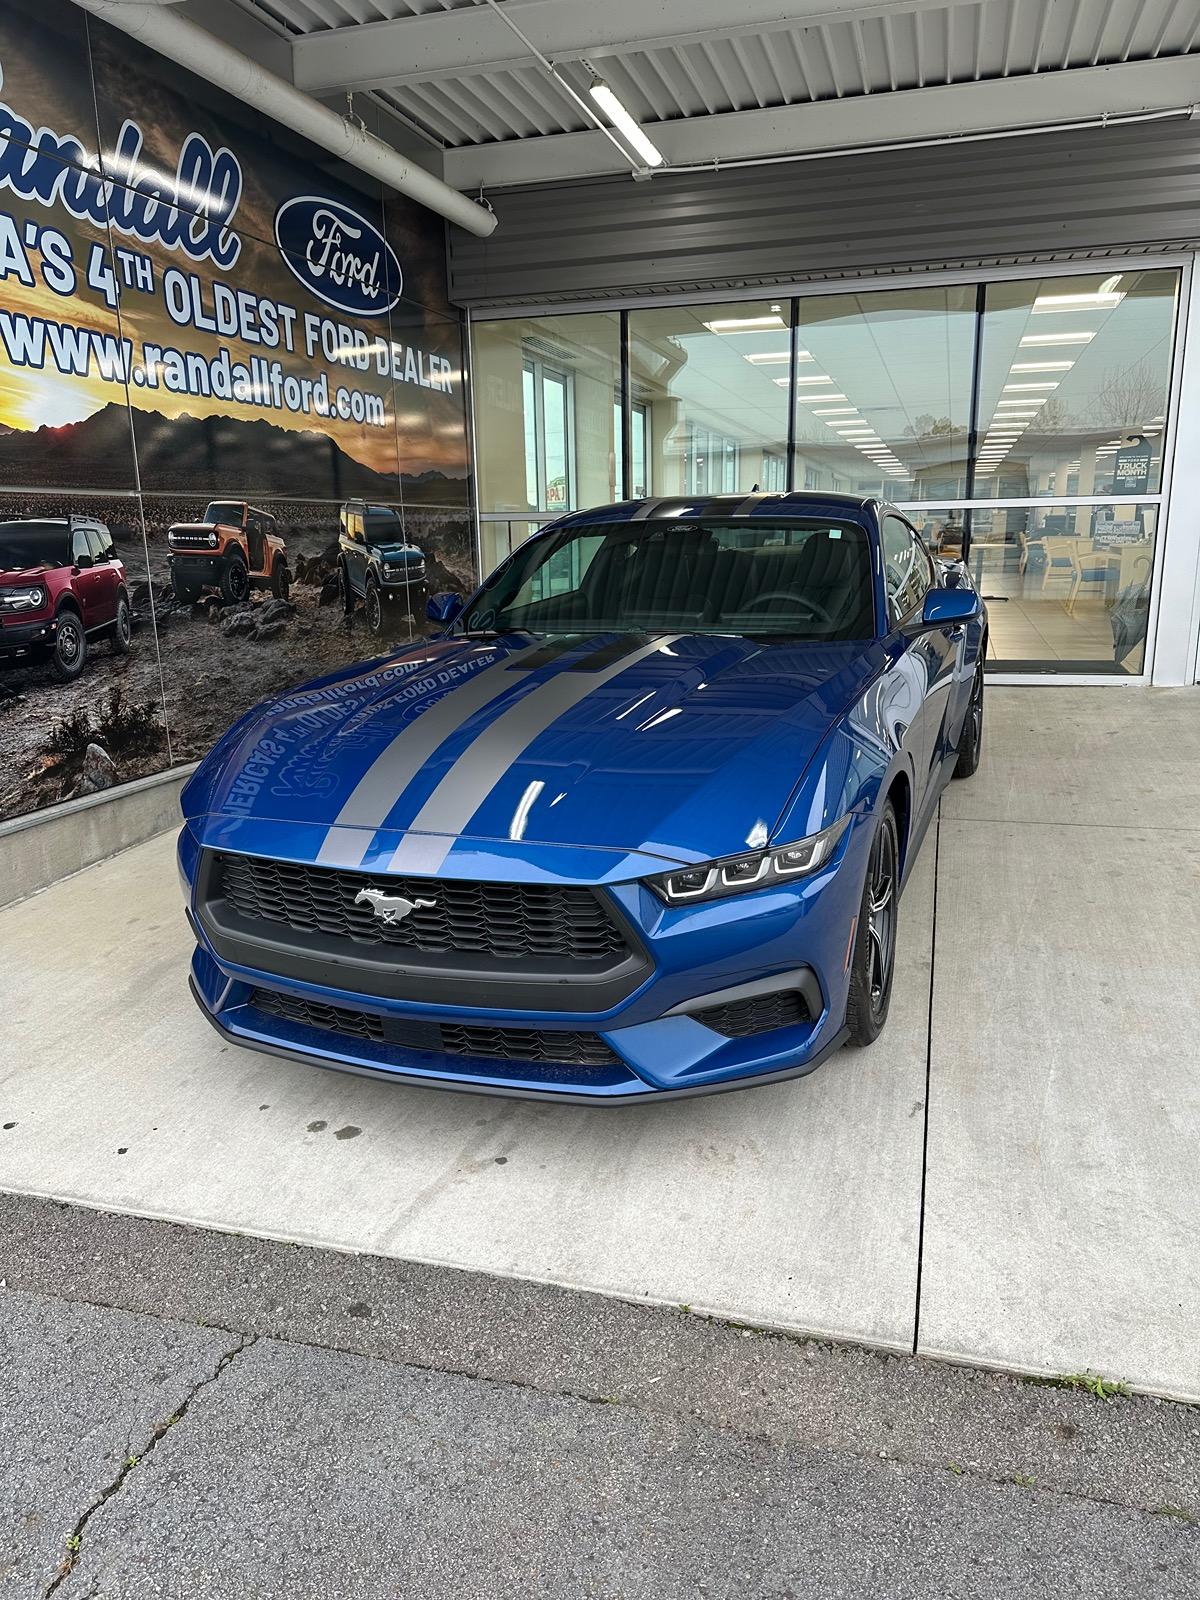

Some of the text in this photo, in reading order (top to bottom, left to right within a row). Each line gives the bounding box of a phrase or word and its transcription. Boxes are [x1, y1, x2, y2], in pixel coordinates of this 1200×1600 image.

[0, 100, 243, 271] andall
[305, 207, 381, 299] Ford
[0, 311, 387, 427] www.randallford.com
[87, 243, 155, 308] 4TH
[163, 268, 298, 352] OLDEST
[303, 311, 370, 373] FORD
[374, 333, 454, 395] DEALER
[1116, 469, 1148, 477] MONTH
[1117, 462, 1148, 471] TRUCK
